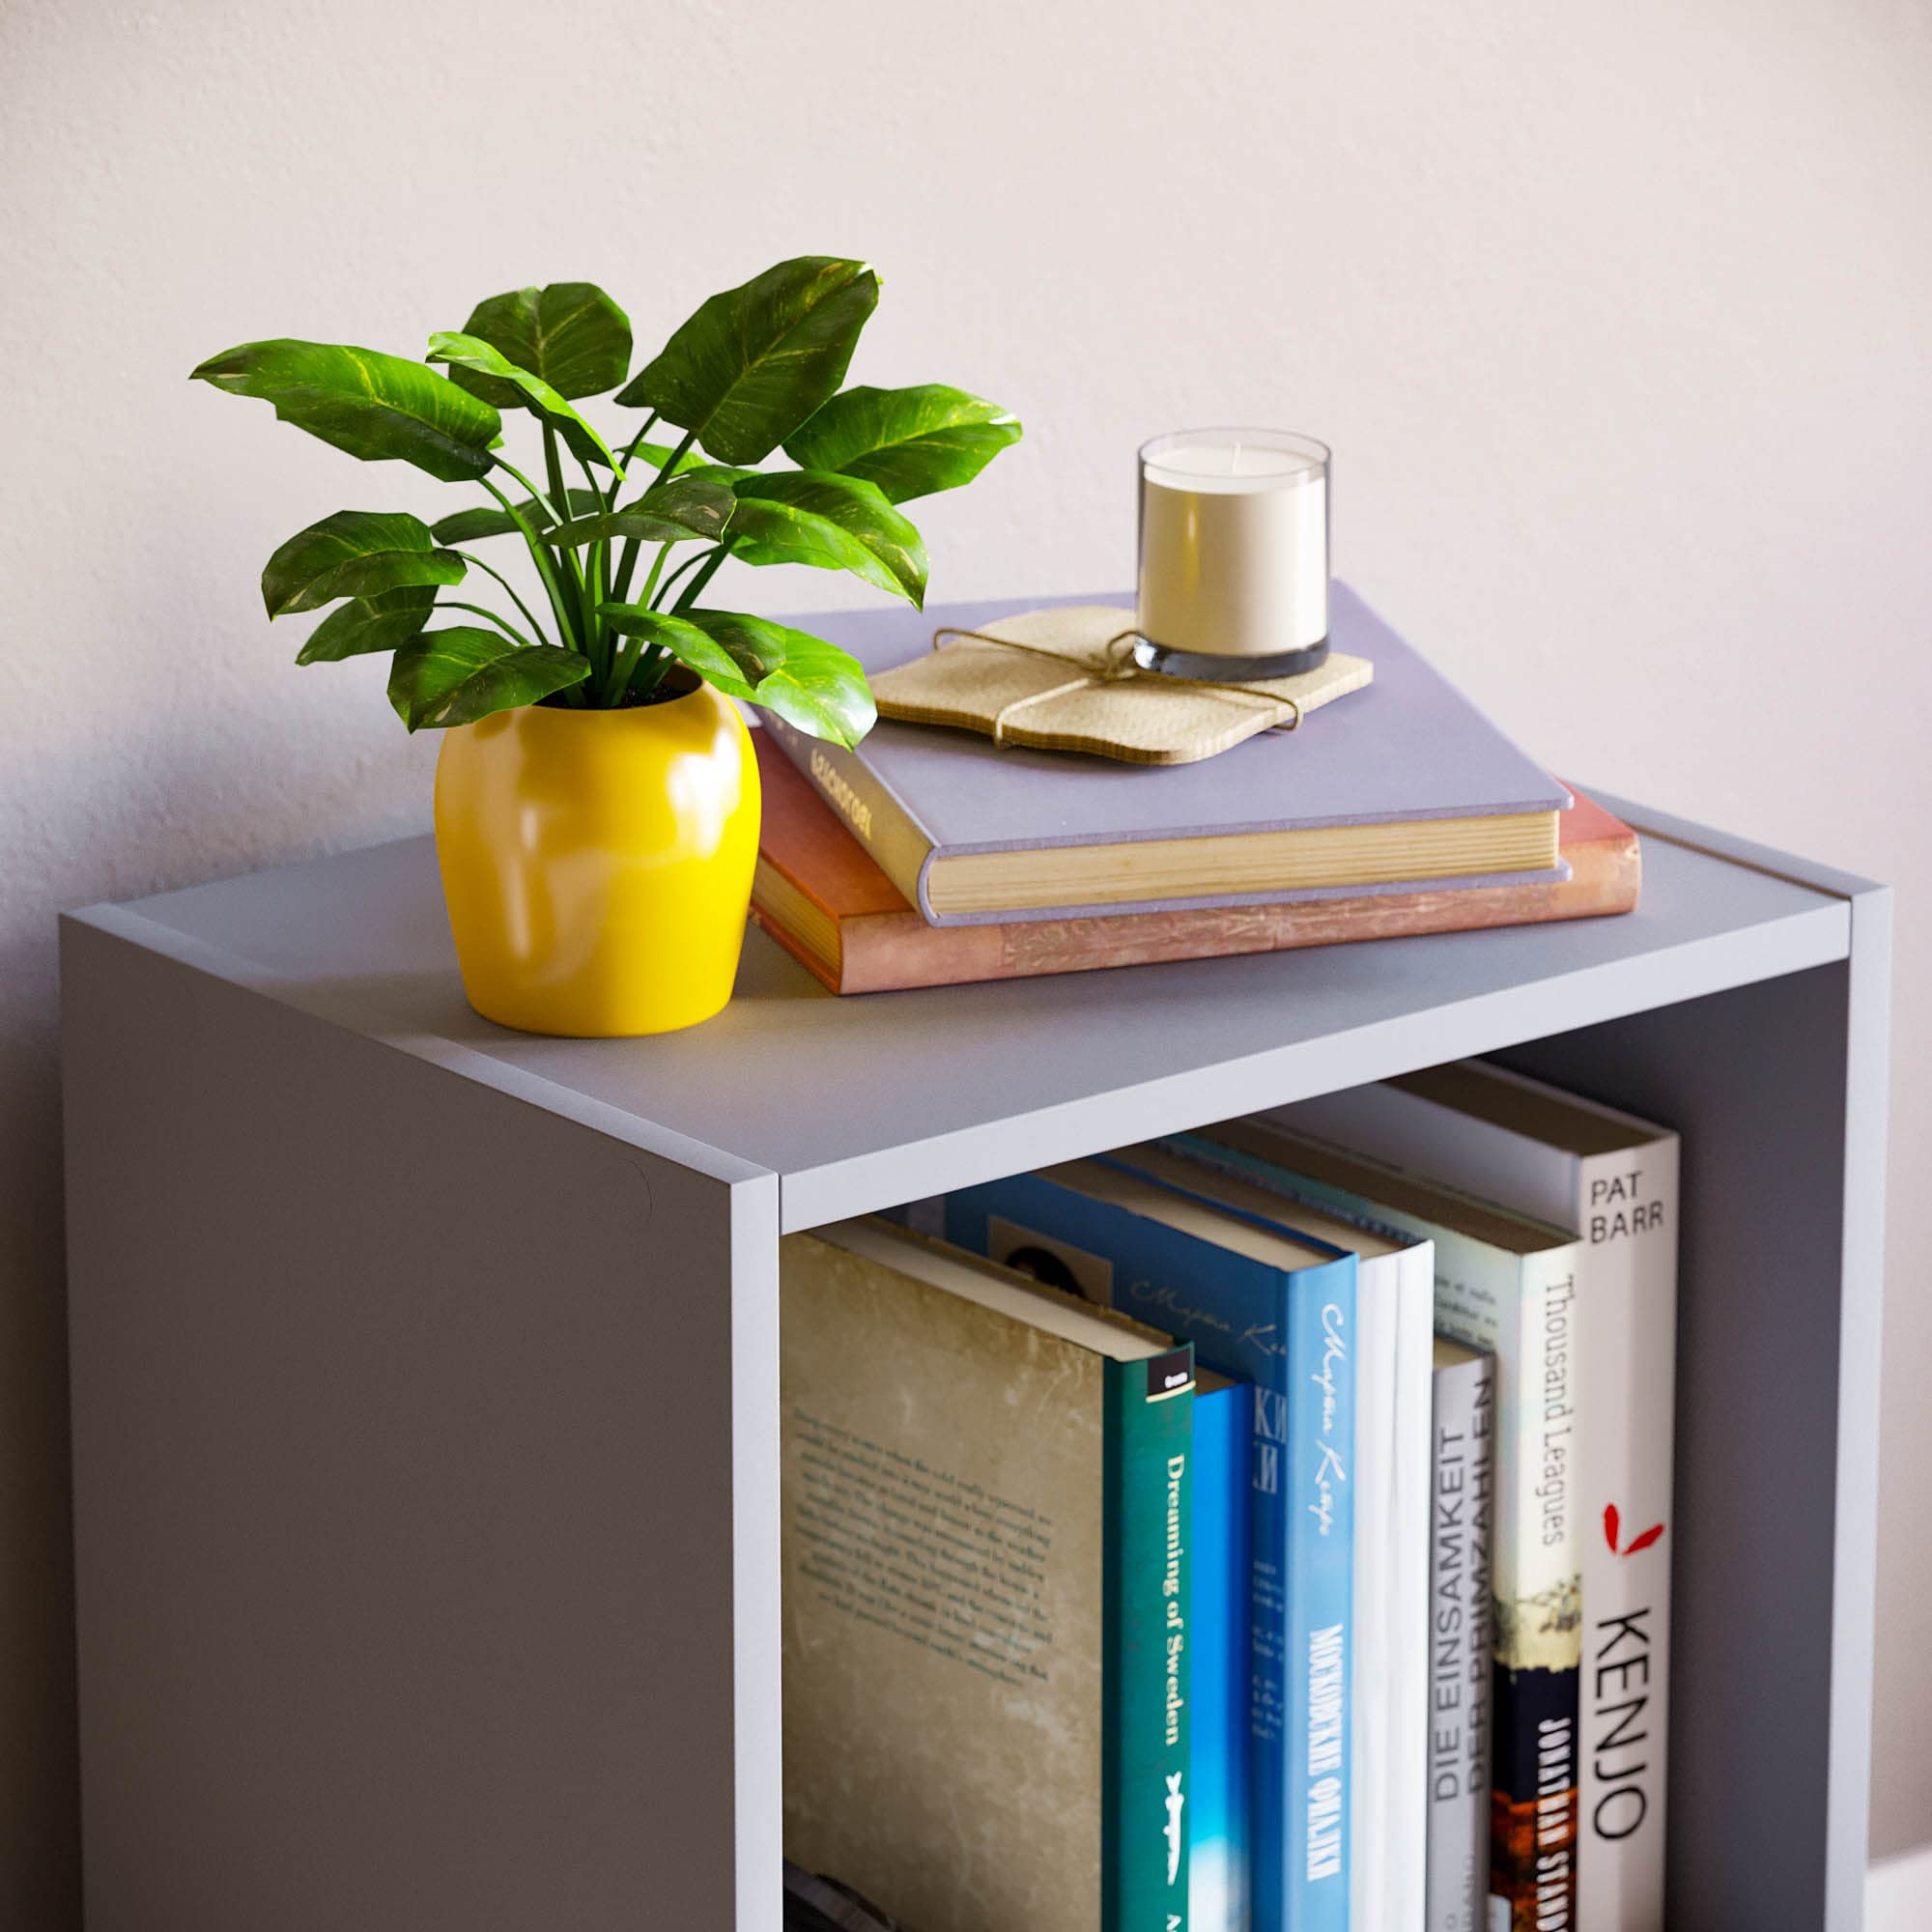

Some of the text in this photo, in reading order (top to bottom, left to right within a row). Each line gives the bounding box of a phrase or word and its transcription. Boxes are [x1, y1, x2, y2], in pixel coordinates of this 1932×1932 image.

[1590, 1201, 1663, 1244] BARR
[1591, 1170, 1643, 1207] PAT
[1537, 1273, 1577, 1548] Thousand Leagues
[1162, 1453, 1185, 1747] Dreaming of Sweden
[1435, 1425, 1464, 1804] DIE EINSAMKEIT
[1466, 1376, 1492, 1796] DER PRIMZAHLEN
[1306, 1622, 1344, 1883] МОСКОВСКИЕ ФИАЛКИ
[1537, 1717, 1572, 1847] JONATHAN
[1591, 1607, 1652, 1842] KENJO
